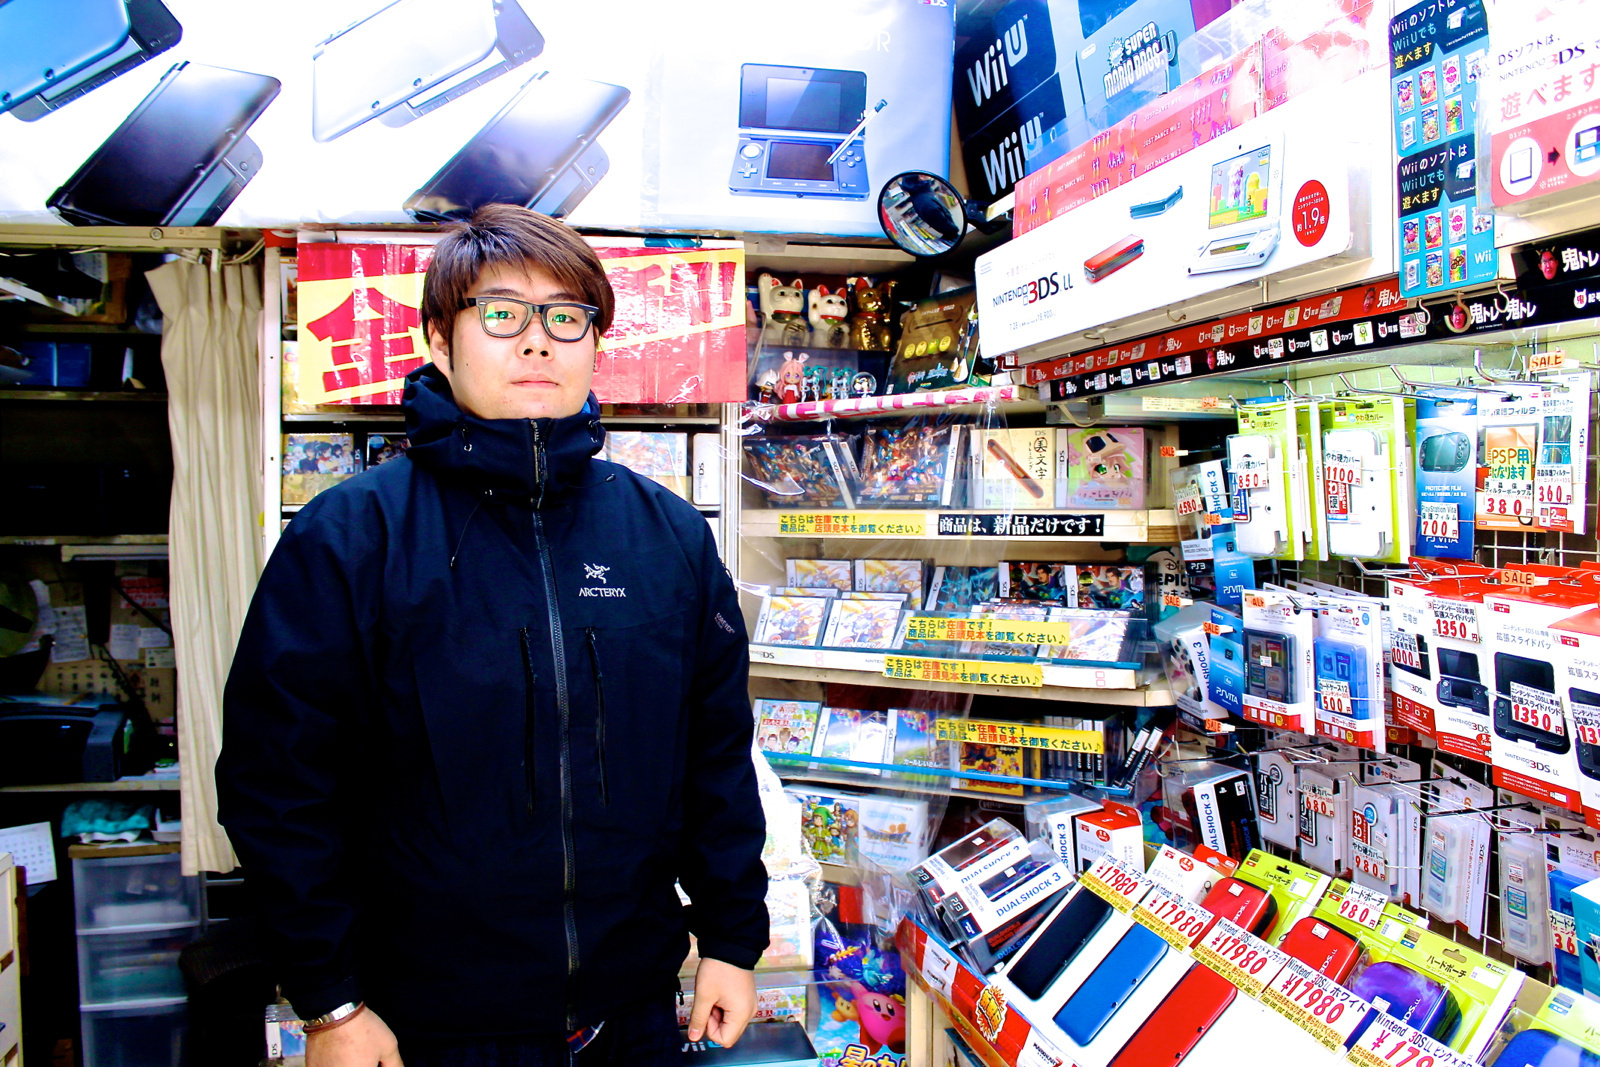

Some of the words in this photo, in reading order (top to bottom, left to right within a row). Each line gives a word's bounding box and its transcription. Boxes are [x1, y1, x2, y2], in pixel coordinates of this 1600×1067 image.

[1124, 21, 1157, 56] SUPER
[1394, 41, 1432, 69] 遊べます
[1546, 42, 1586, 70] 3DS
[1103, 58, 1135, 99] MARIO
[1500, 63, 1600, 123] 遊べます
[1401, 144, 1467, 176] Wiiのソフトは
[1402, 187, 1440, 210] 遊べます
[1474, 250, 1492, 264] Wii
[1562, 248, 1599, 273] 鬼トレ
[992, 284, 1028, 307] NINTENDO
[1027, 272, 1059, 304] 3DS
[1470, 303, 1499, 324] 鬼トレ
[1505, 298, 1536, 321] 鬼トレ
[1216, 349, 1235, 366] 鬼トレ
[1531, 355, 1562, 369] SALE
[1161, 447, 1175, 457] SALE
[1491, 449, 1530, 465] PSP用
[1207, 470, 1216, 478] 3
[1421, 505, 1448, 514] PlayStation
[1449, 506, 1457, 514] Vita
[939, 515, 1101, 536] 商品は、新品だけです！
[1191, 562, 1206, 570] PS3
[1503, 571, 1532, 585] SALE
[1165, 595, 1181, 606] SALE
[908, 618, 993, 631] こちらは在庫です！
[1203, 623, 1220, 635] SALE
[762, 651, 775, 659] DS
[886, 658, 966, 672] こちらは在庫です！
[1206, 719, 1221, 732] SALE
[1471, 722, 1489, 734] 3DS
[1505, 752, 1530, 765] NINTENDO
[1529, 760, 1551, 773] 3DS
[1203, 805, 1220, 852] UALSHOCK
[917, 869, 930, 882] PS3
[950, 897, 964, 912] PS3
[996, 879, 1053, 917] DUALSHOCK
[1052, 872, 1062, 882] 3
[1348, 884, 1385, 906] ハードポーチ
[1149, 894, 1204, 938] ¥17980
[1210, 931, 1268, 974] ¥17980
[1427, 955, 1467, 978] ハードポーチ
[1280, 973, 1345, 1024] ¥17980
[1330, 986, 1366, 1013] ホワイト
